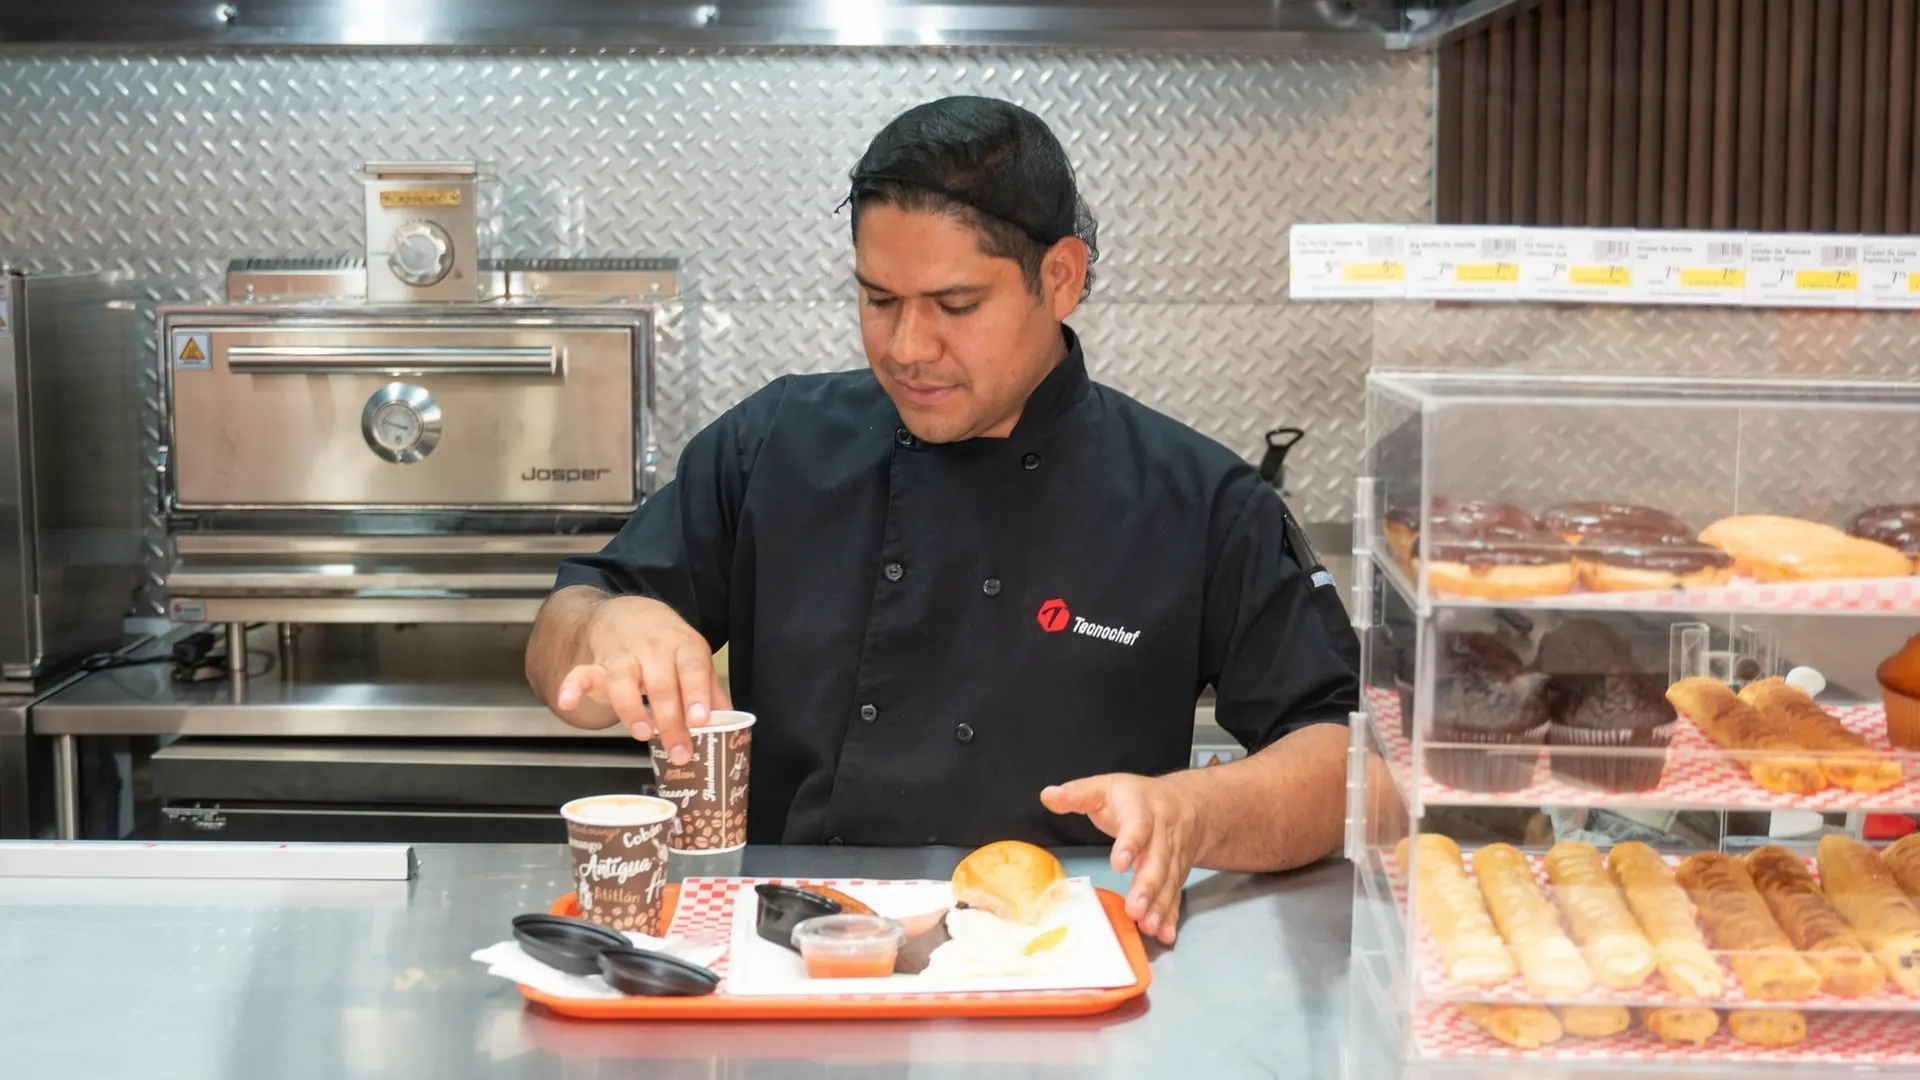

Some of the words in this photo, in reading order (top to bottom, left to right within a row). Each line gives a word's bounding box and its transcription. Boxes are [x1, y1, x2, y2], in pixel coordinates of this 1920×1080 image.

[521, 466, 611, 483] Josper
[1073, 616, 1141, 646] Tecnochef
[579, 854, 652, 884] Antigua
